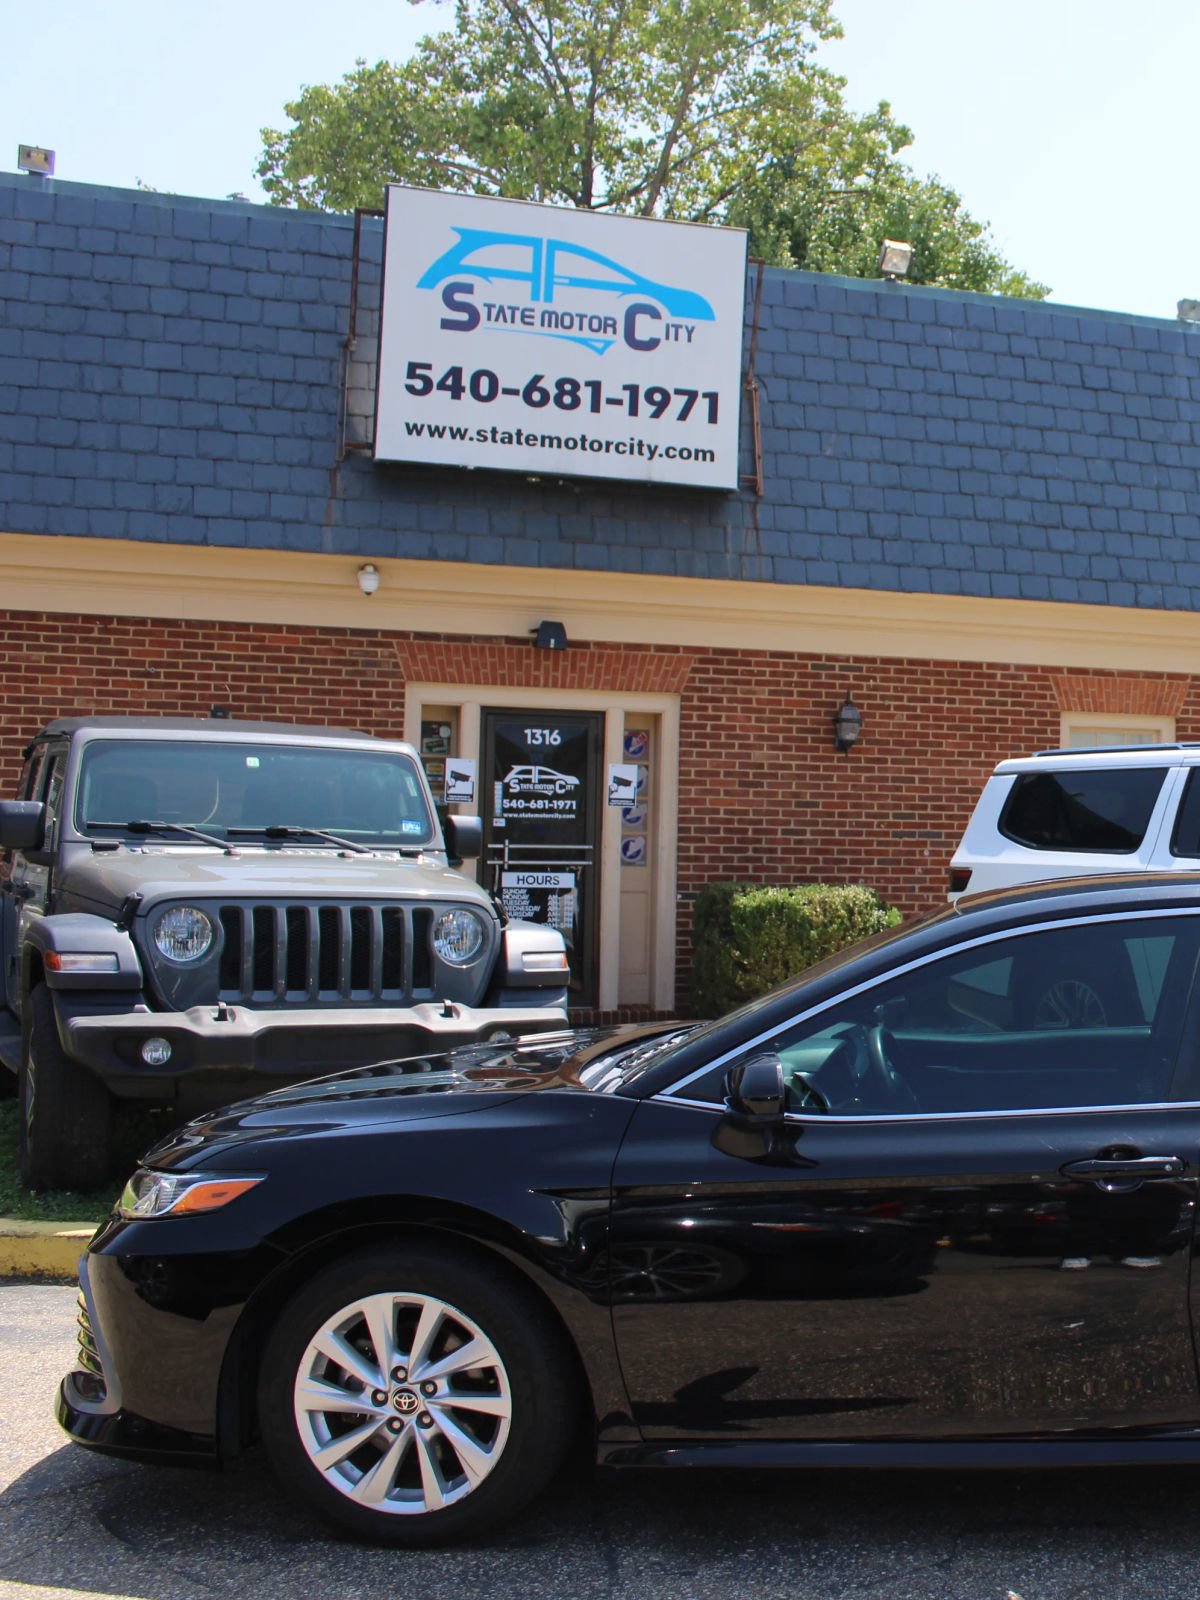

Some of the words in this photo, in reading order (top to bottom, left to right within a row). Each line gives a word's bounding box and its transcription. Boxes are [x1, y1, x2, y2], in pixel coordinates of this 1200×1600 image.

[440, 281, 535, 333] STATE
[540, 310, 618, 336] MOTOR
[623, 302, 696, 352] CITY
[404, 361, 719, 425] 540-681-1971
[404, 421, 716, 463] www.statemotorcity.com
[524, 728, 561, 746] 1316
[503, 799, 577, 810] 540-681-1971
[503, 812, 576, 820] www.statemotorcity.com
[516, 875, 560, 886] HOURS
